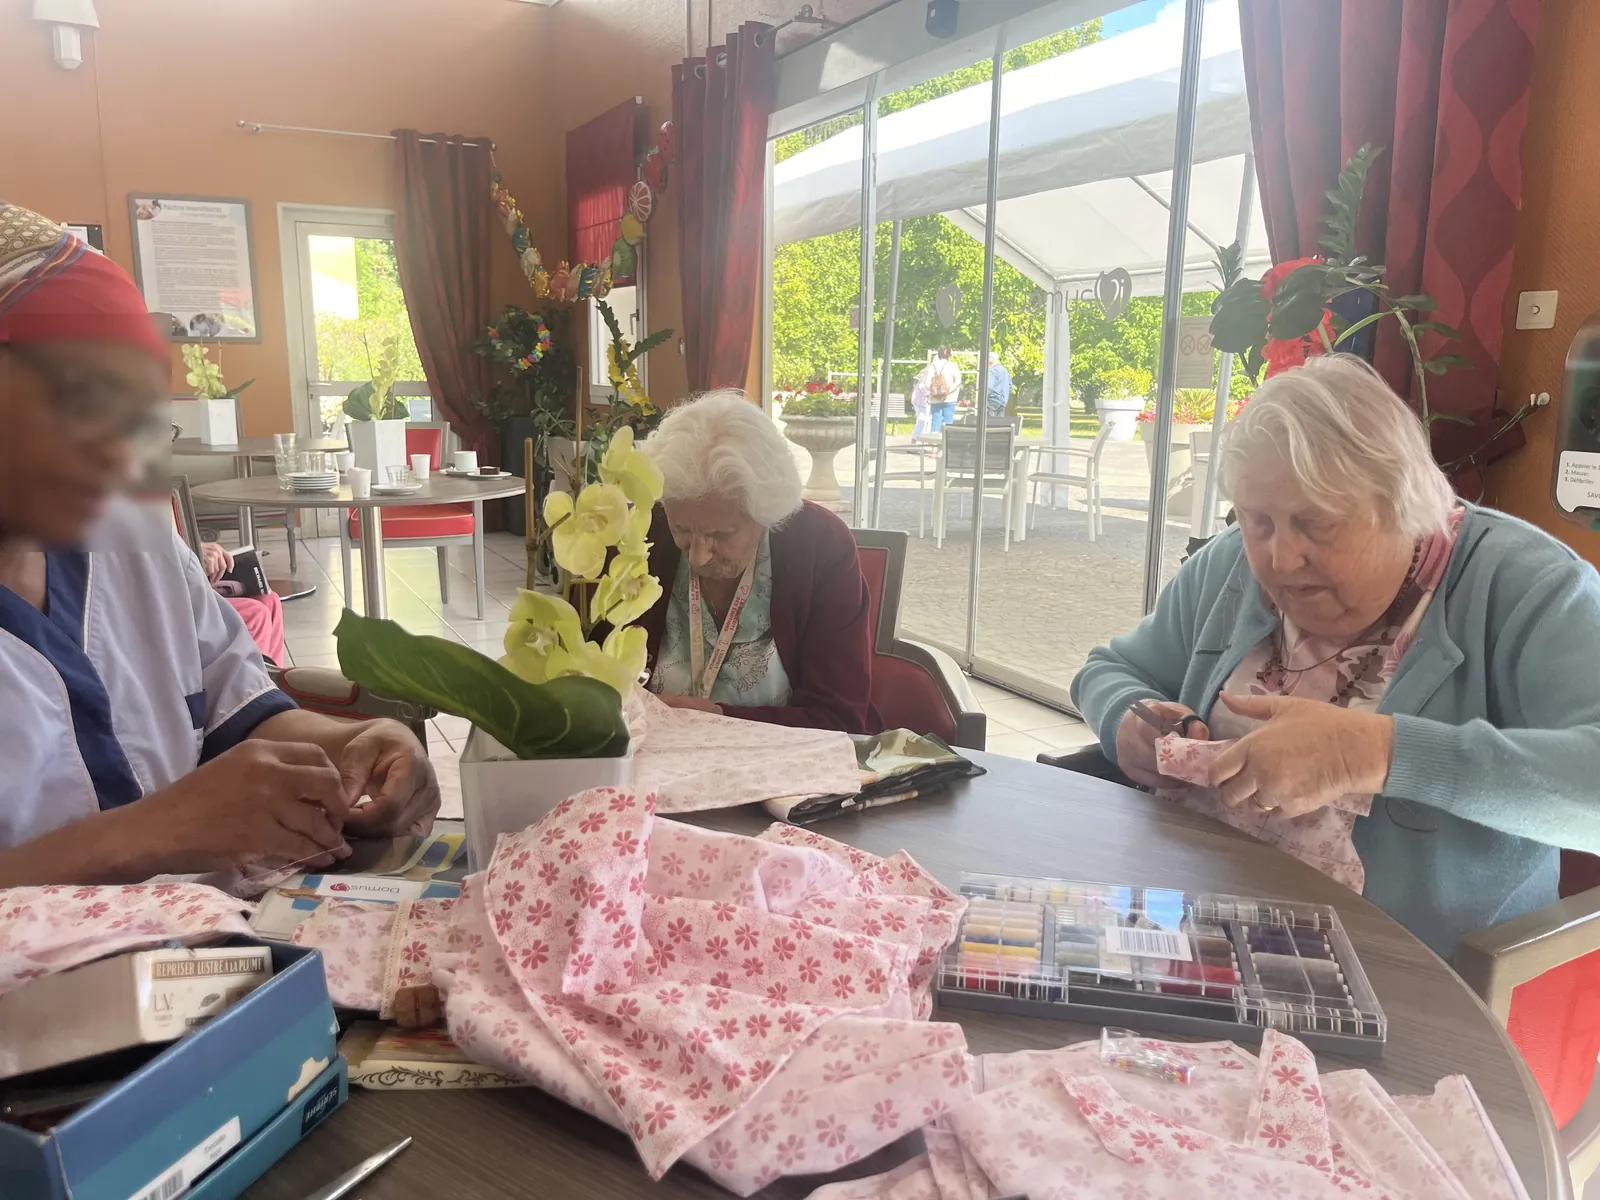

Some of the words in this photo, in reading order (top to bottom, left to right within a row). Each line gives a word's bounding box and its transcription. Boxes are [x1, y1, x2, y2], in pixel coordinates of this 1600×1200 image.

[156, 962, 195, 977] REPRISER
[197, 959, 223, 975] LUSTRE
[239, 958, 262, 972] PLUME
